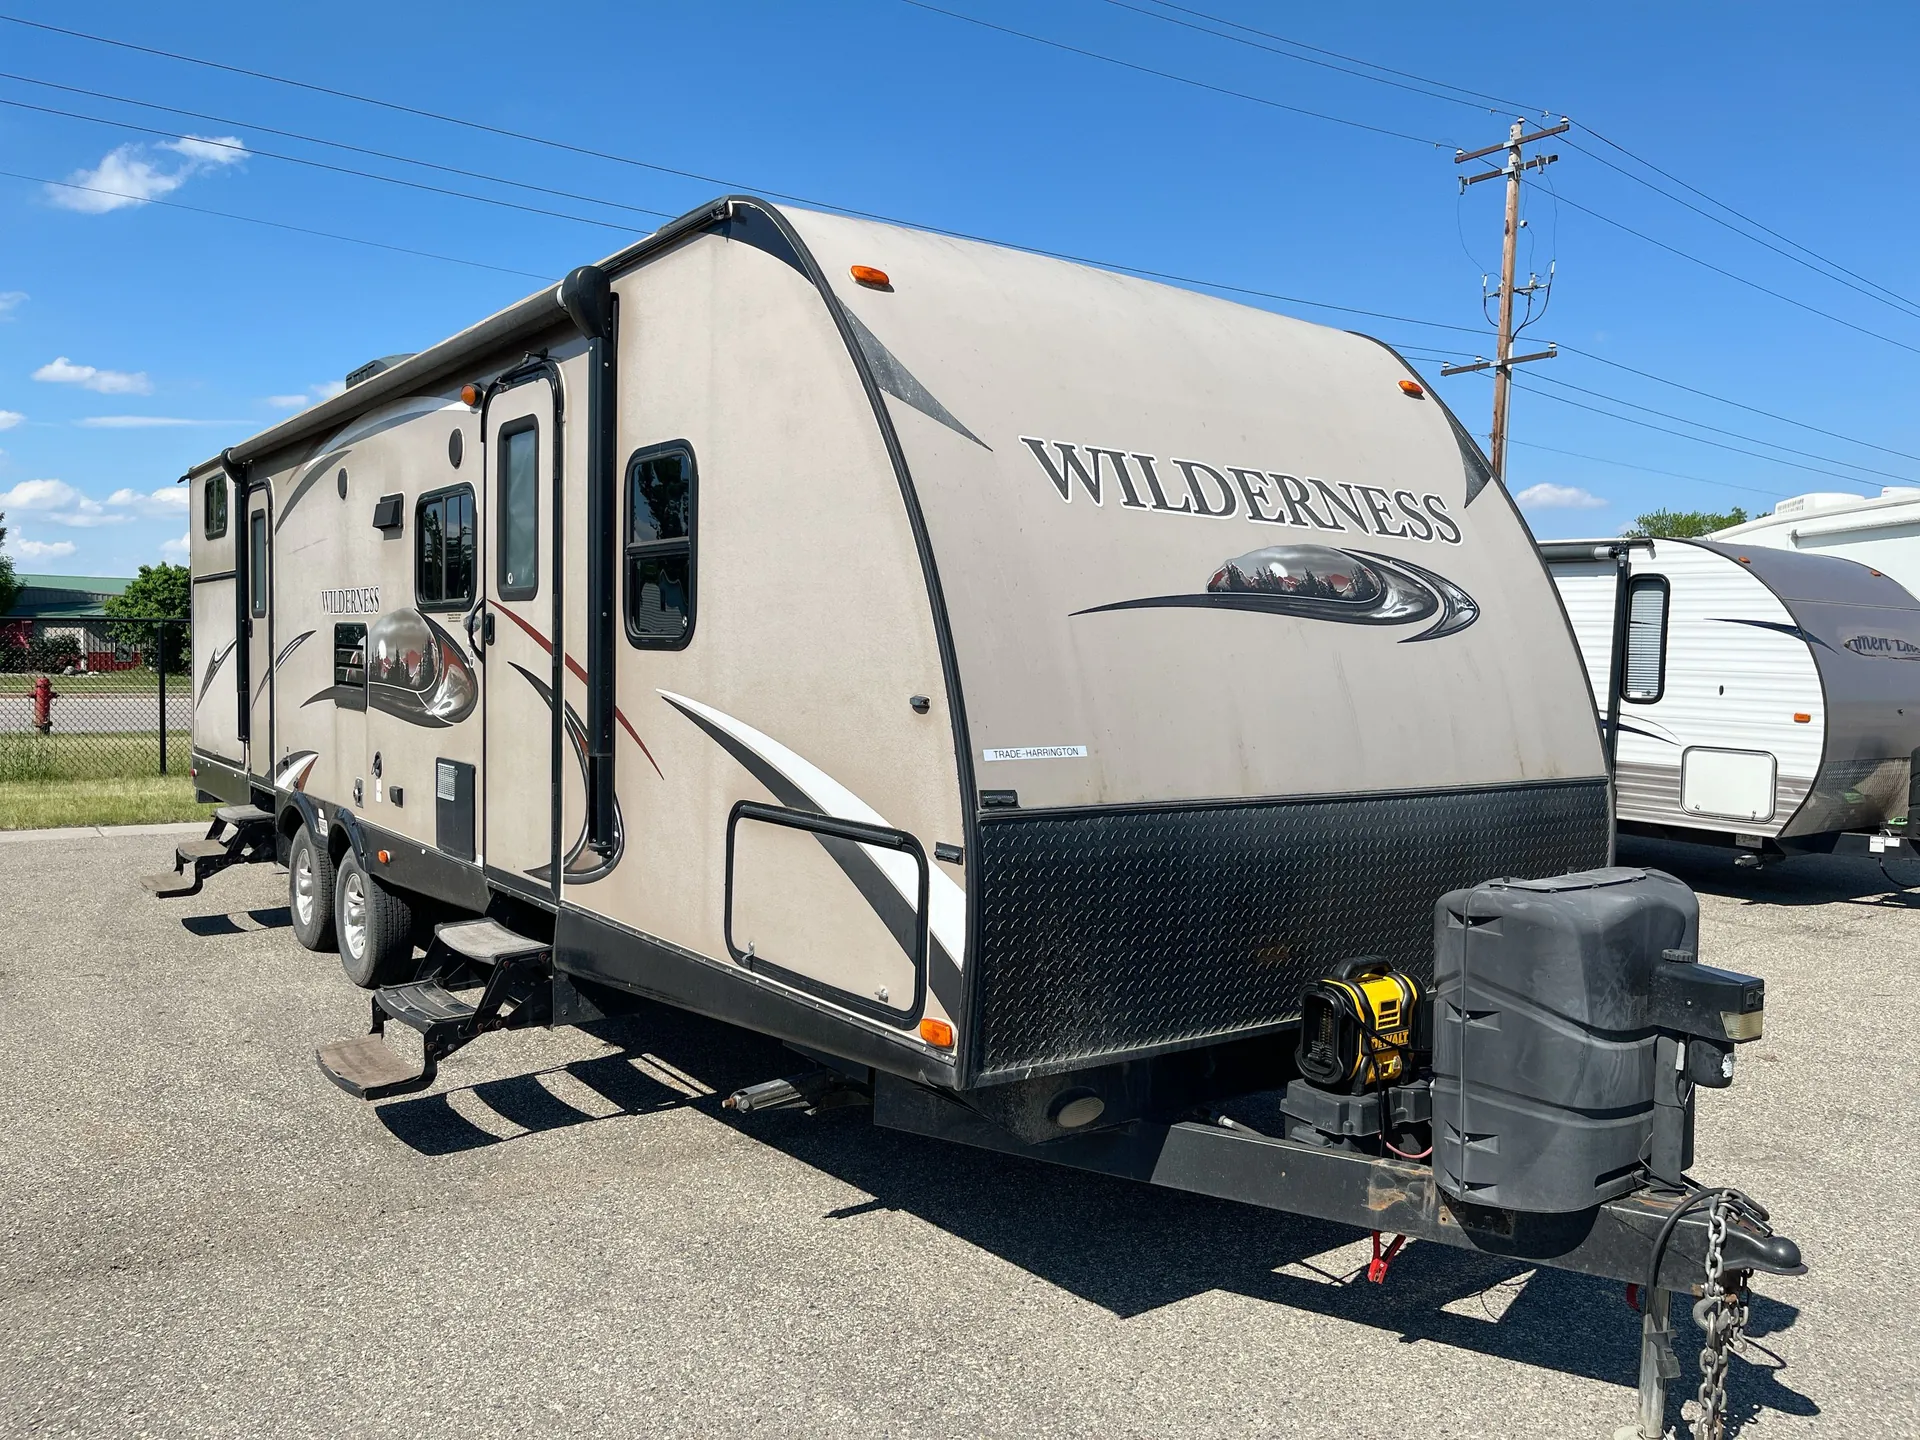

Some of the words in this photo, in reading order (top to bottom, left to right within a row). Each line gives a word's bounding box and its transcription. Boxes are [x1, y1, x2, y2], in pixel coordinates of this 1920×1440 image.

[1020, 435, 1462, 544] WILDERNESS
[321, 586, 380, 614] WILDERNESS
[993, 747, 1079, 759] TRADE-HARRINGTON
